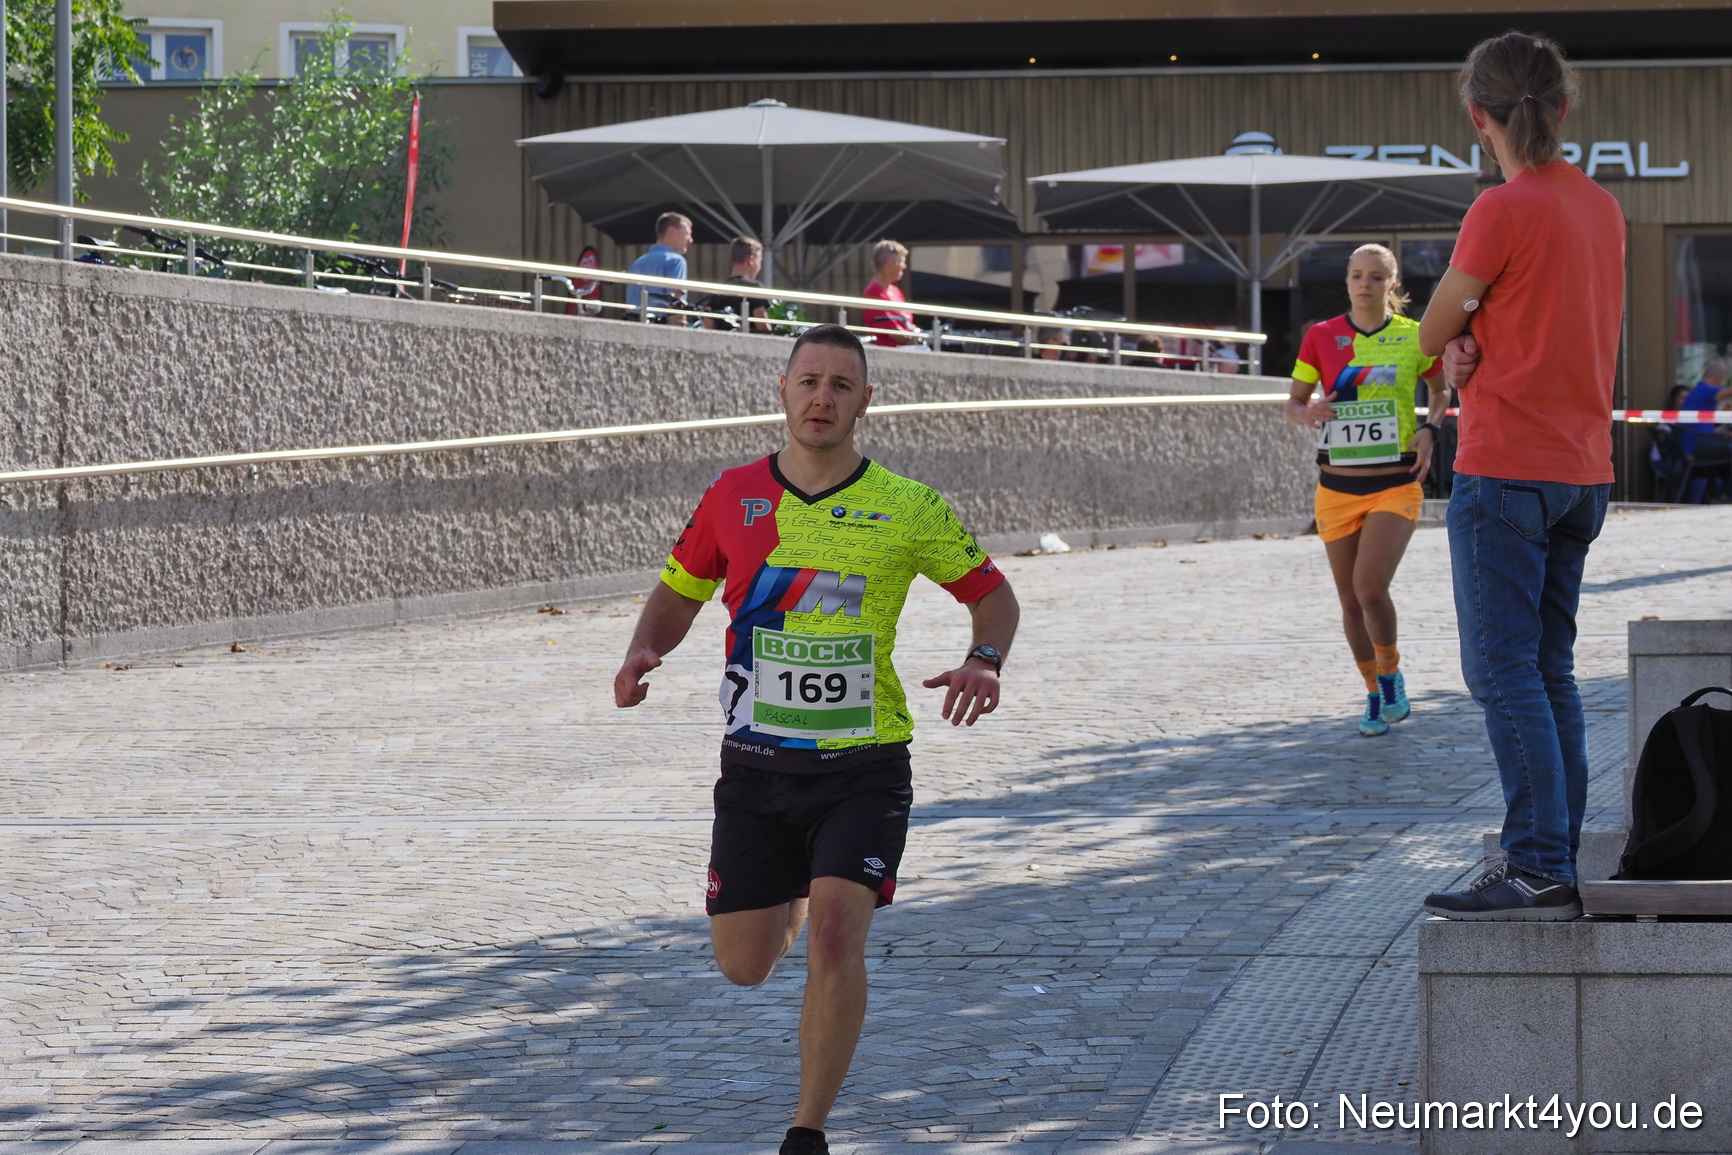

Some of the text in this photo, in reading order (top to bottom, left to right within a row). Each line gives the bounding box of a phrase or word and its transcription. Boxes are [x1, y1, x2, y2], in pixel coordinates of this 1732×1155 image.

[1336, 402, 1391, 419] BOCK
[1342, 422, 1383, 443] 176
[763, 635, 861, 663] BOCK
[778, 671, 848, 703] 169
[764, 708, 808, 725] PASCAL
[863, 867, 883, 878] umbro
